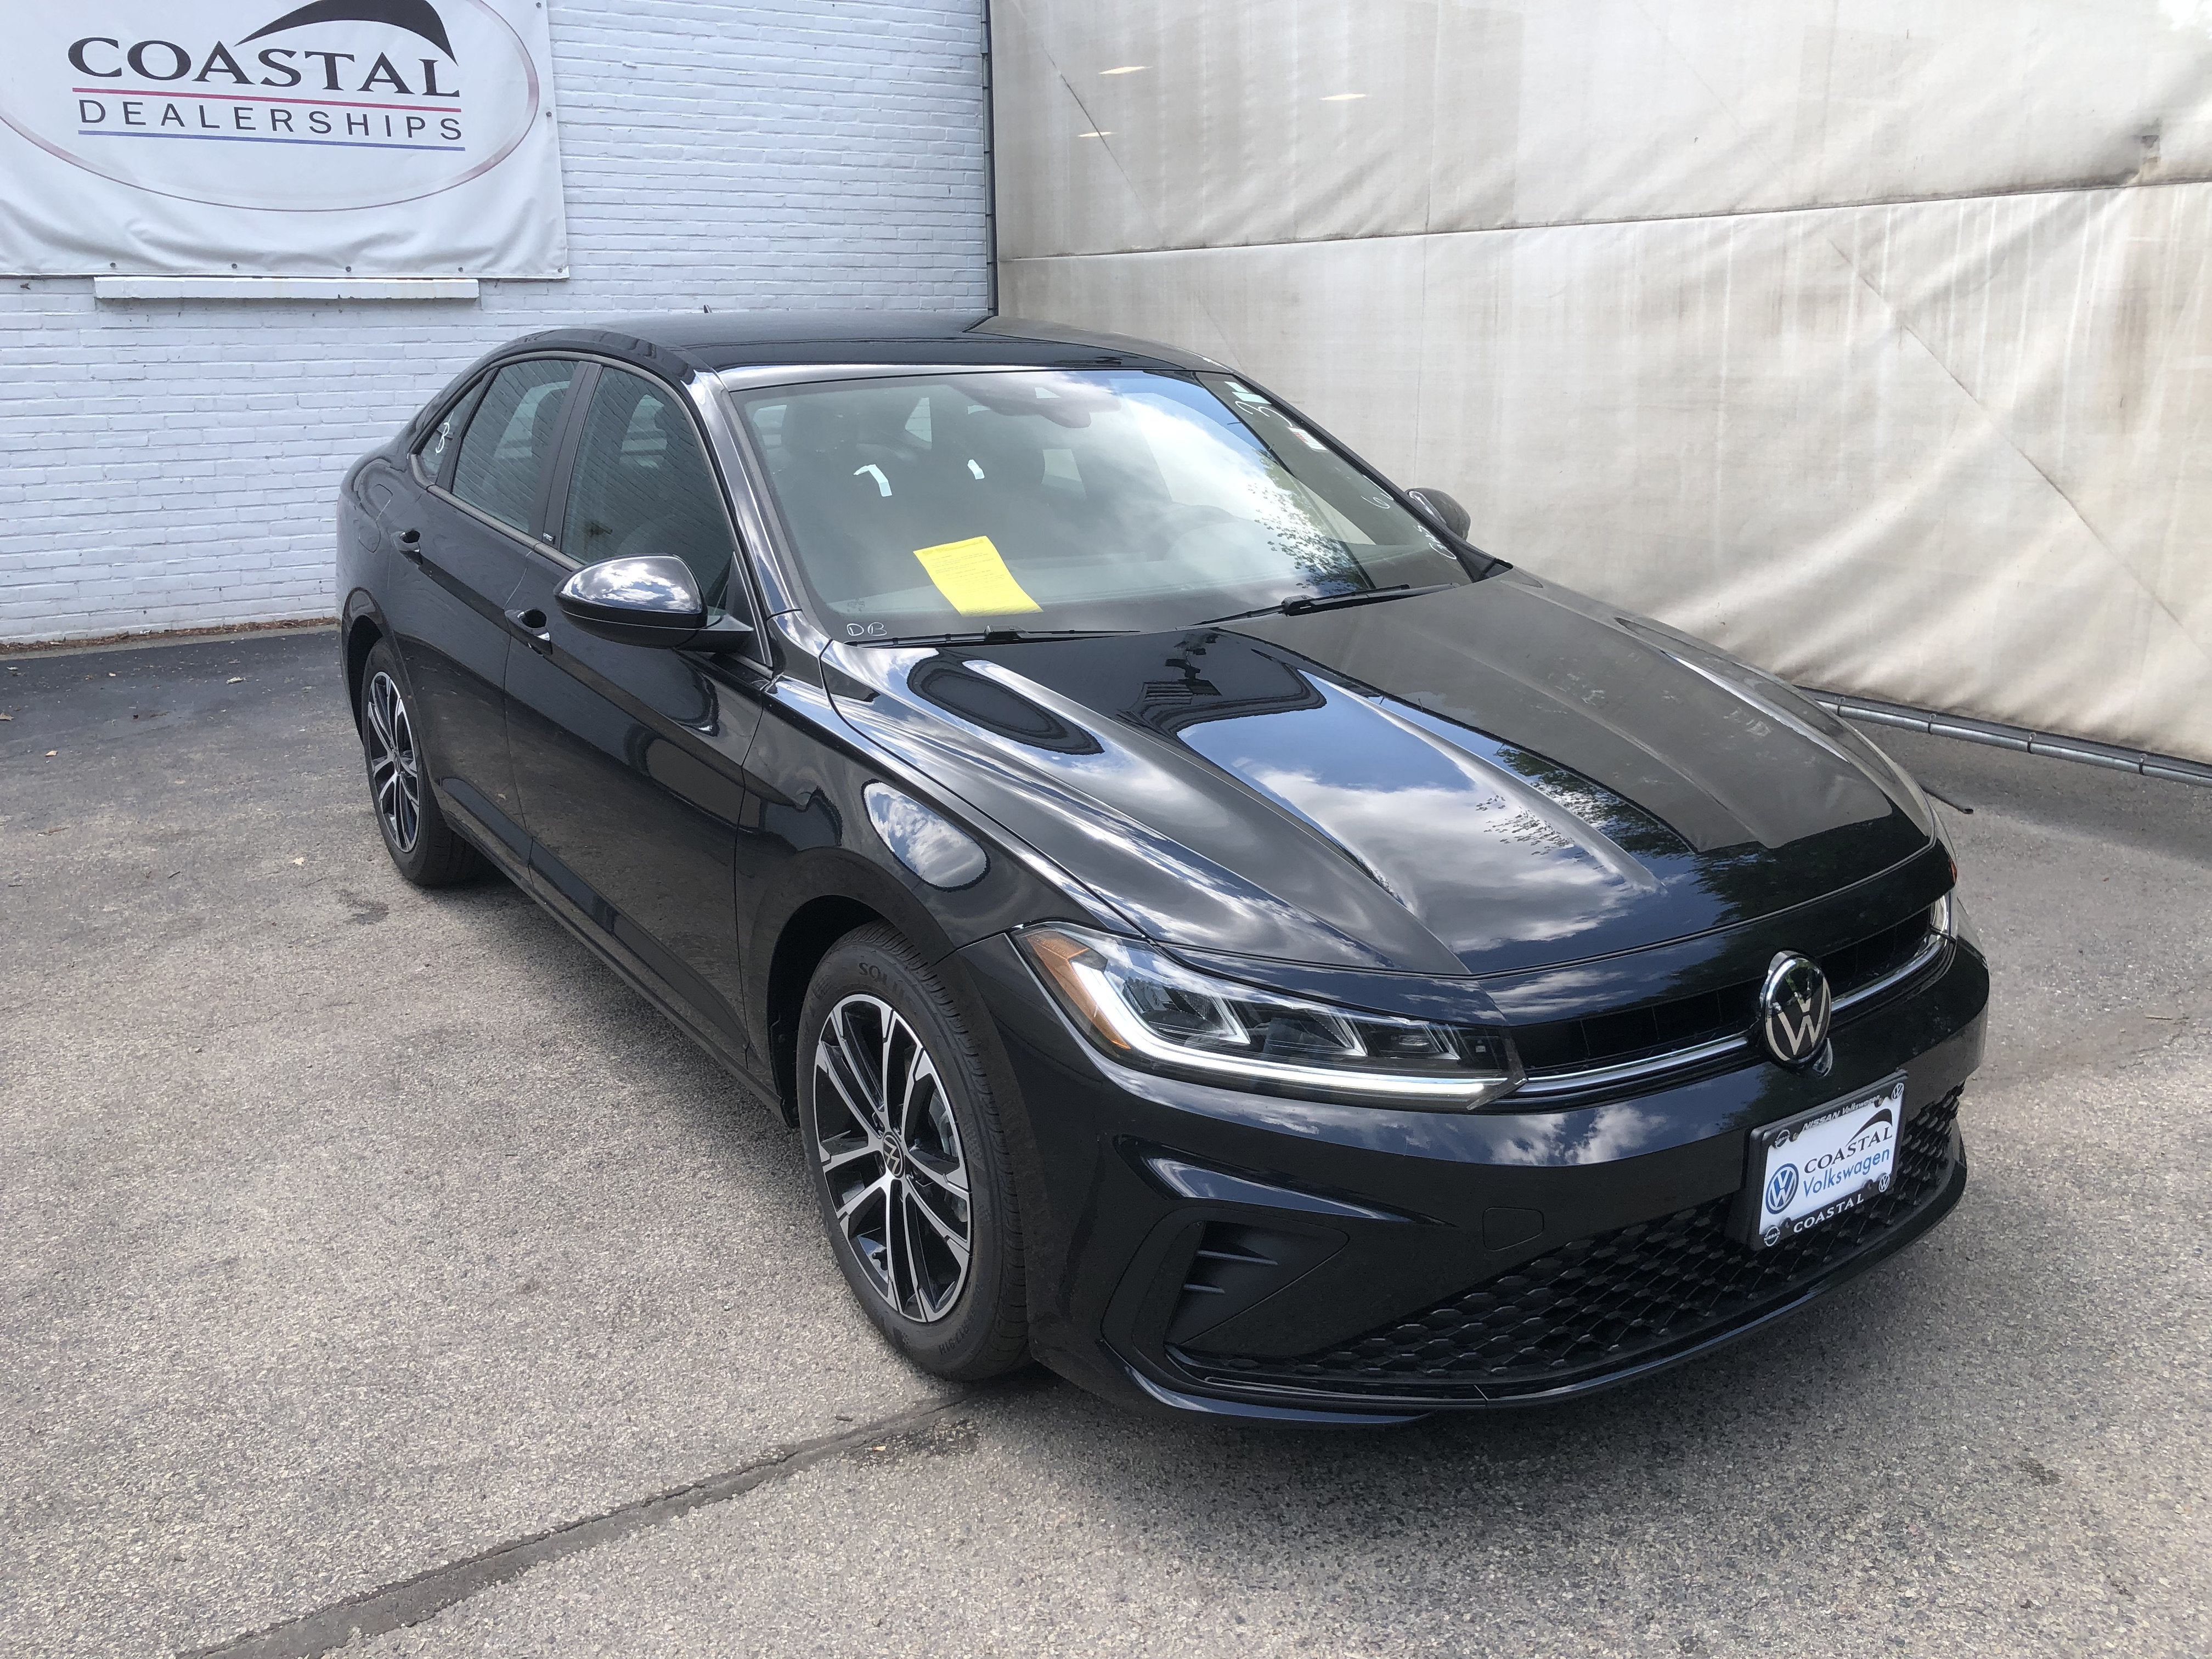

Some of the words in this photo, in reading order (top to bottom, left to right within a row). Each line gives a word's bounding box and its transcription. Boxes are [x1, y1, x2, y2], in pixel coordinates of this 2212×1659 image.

[67, 36, 460, 98] COASTAL
[78, 99, 463, 141] DEALERSHIPS
[1802, 1110, 1840, 1131] NISSAN
[1804, 1126, 1892, 1173] COASTAL
[1803, 1149, 1890, 1198] Volkswagen
[1793, 1193, 1864, 1233] COASTAL
